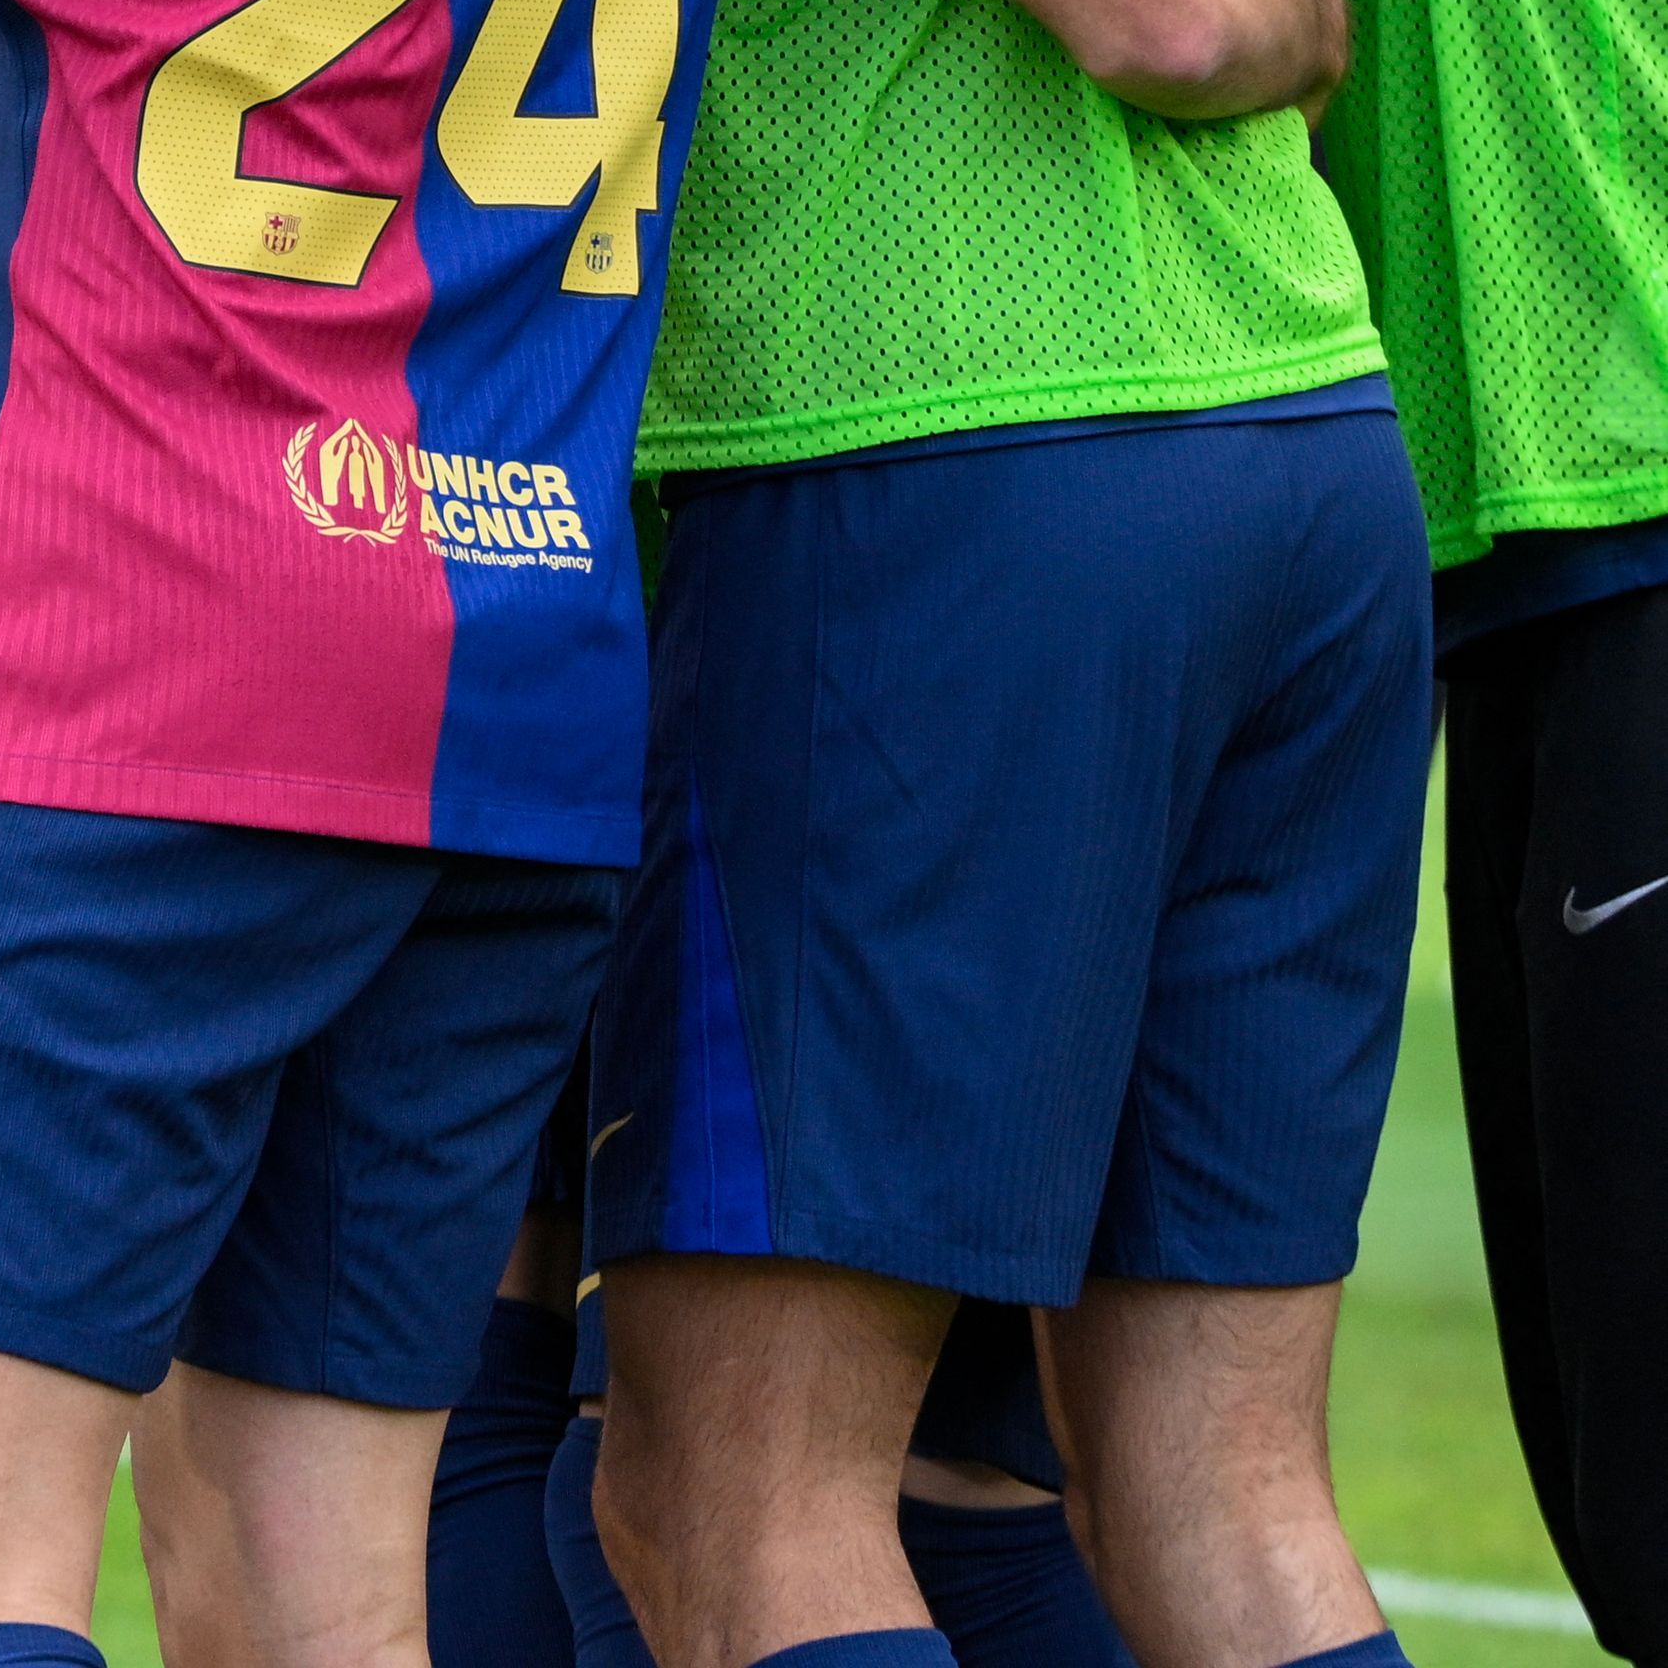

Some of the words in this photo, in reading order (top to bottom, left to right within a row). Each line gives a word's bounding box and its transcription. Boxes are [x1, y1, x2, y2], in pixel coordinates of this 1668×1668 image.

[406, 443, 576, 506] UNHCR
[420, 493, 591, 550] ACNUR
[423, 537, 449, 559] The
[451, 544, 471, 564] UN
[472, 548, 537, 570] Refugee
[539, 550, 594, 574] Agency
